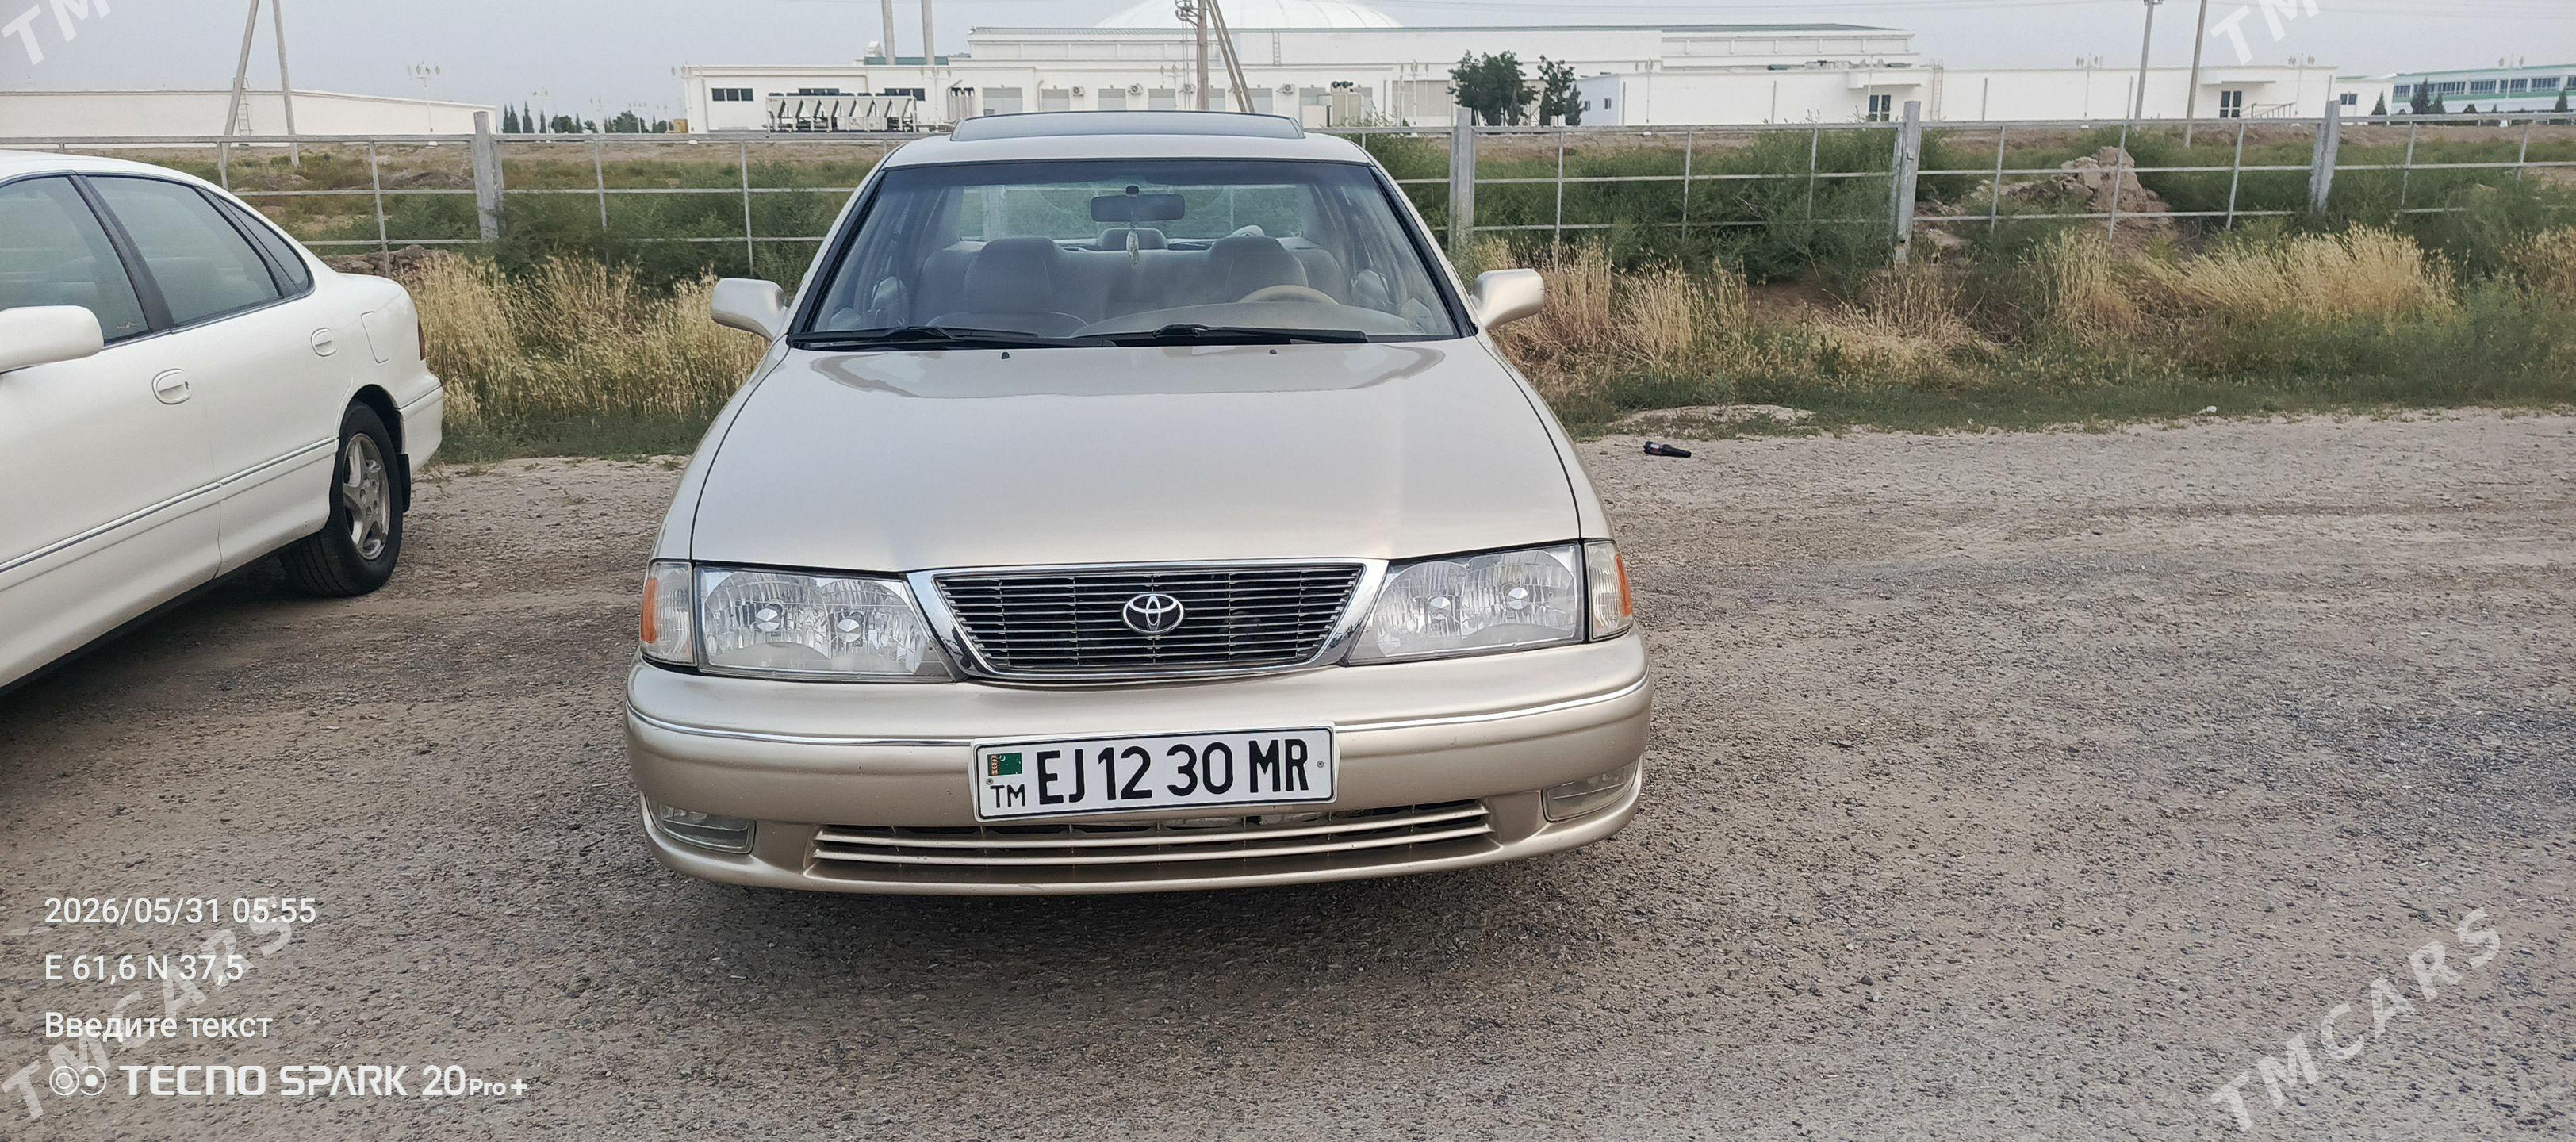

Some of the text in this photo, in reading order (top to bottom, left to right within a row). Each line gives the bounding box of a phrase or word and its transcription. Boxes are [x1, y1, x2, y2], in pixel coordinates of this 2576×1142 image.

[990, 738, 1310, 809] TM EJ 12 30 MR
